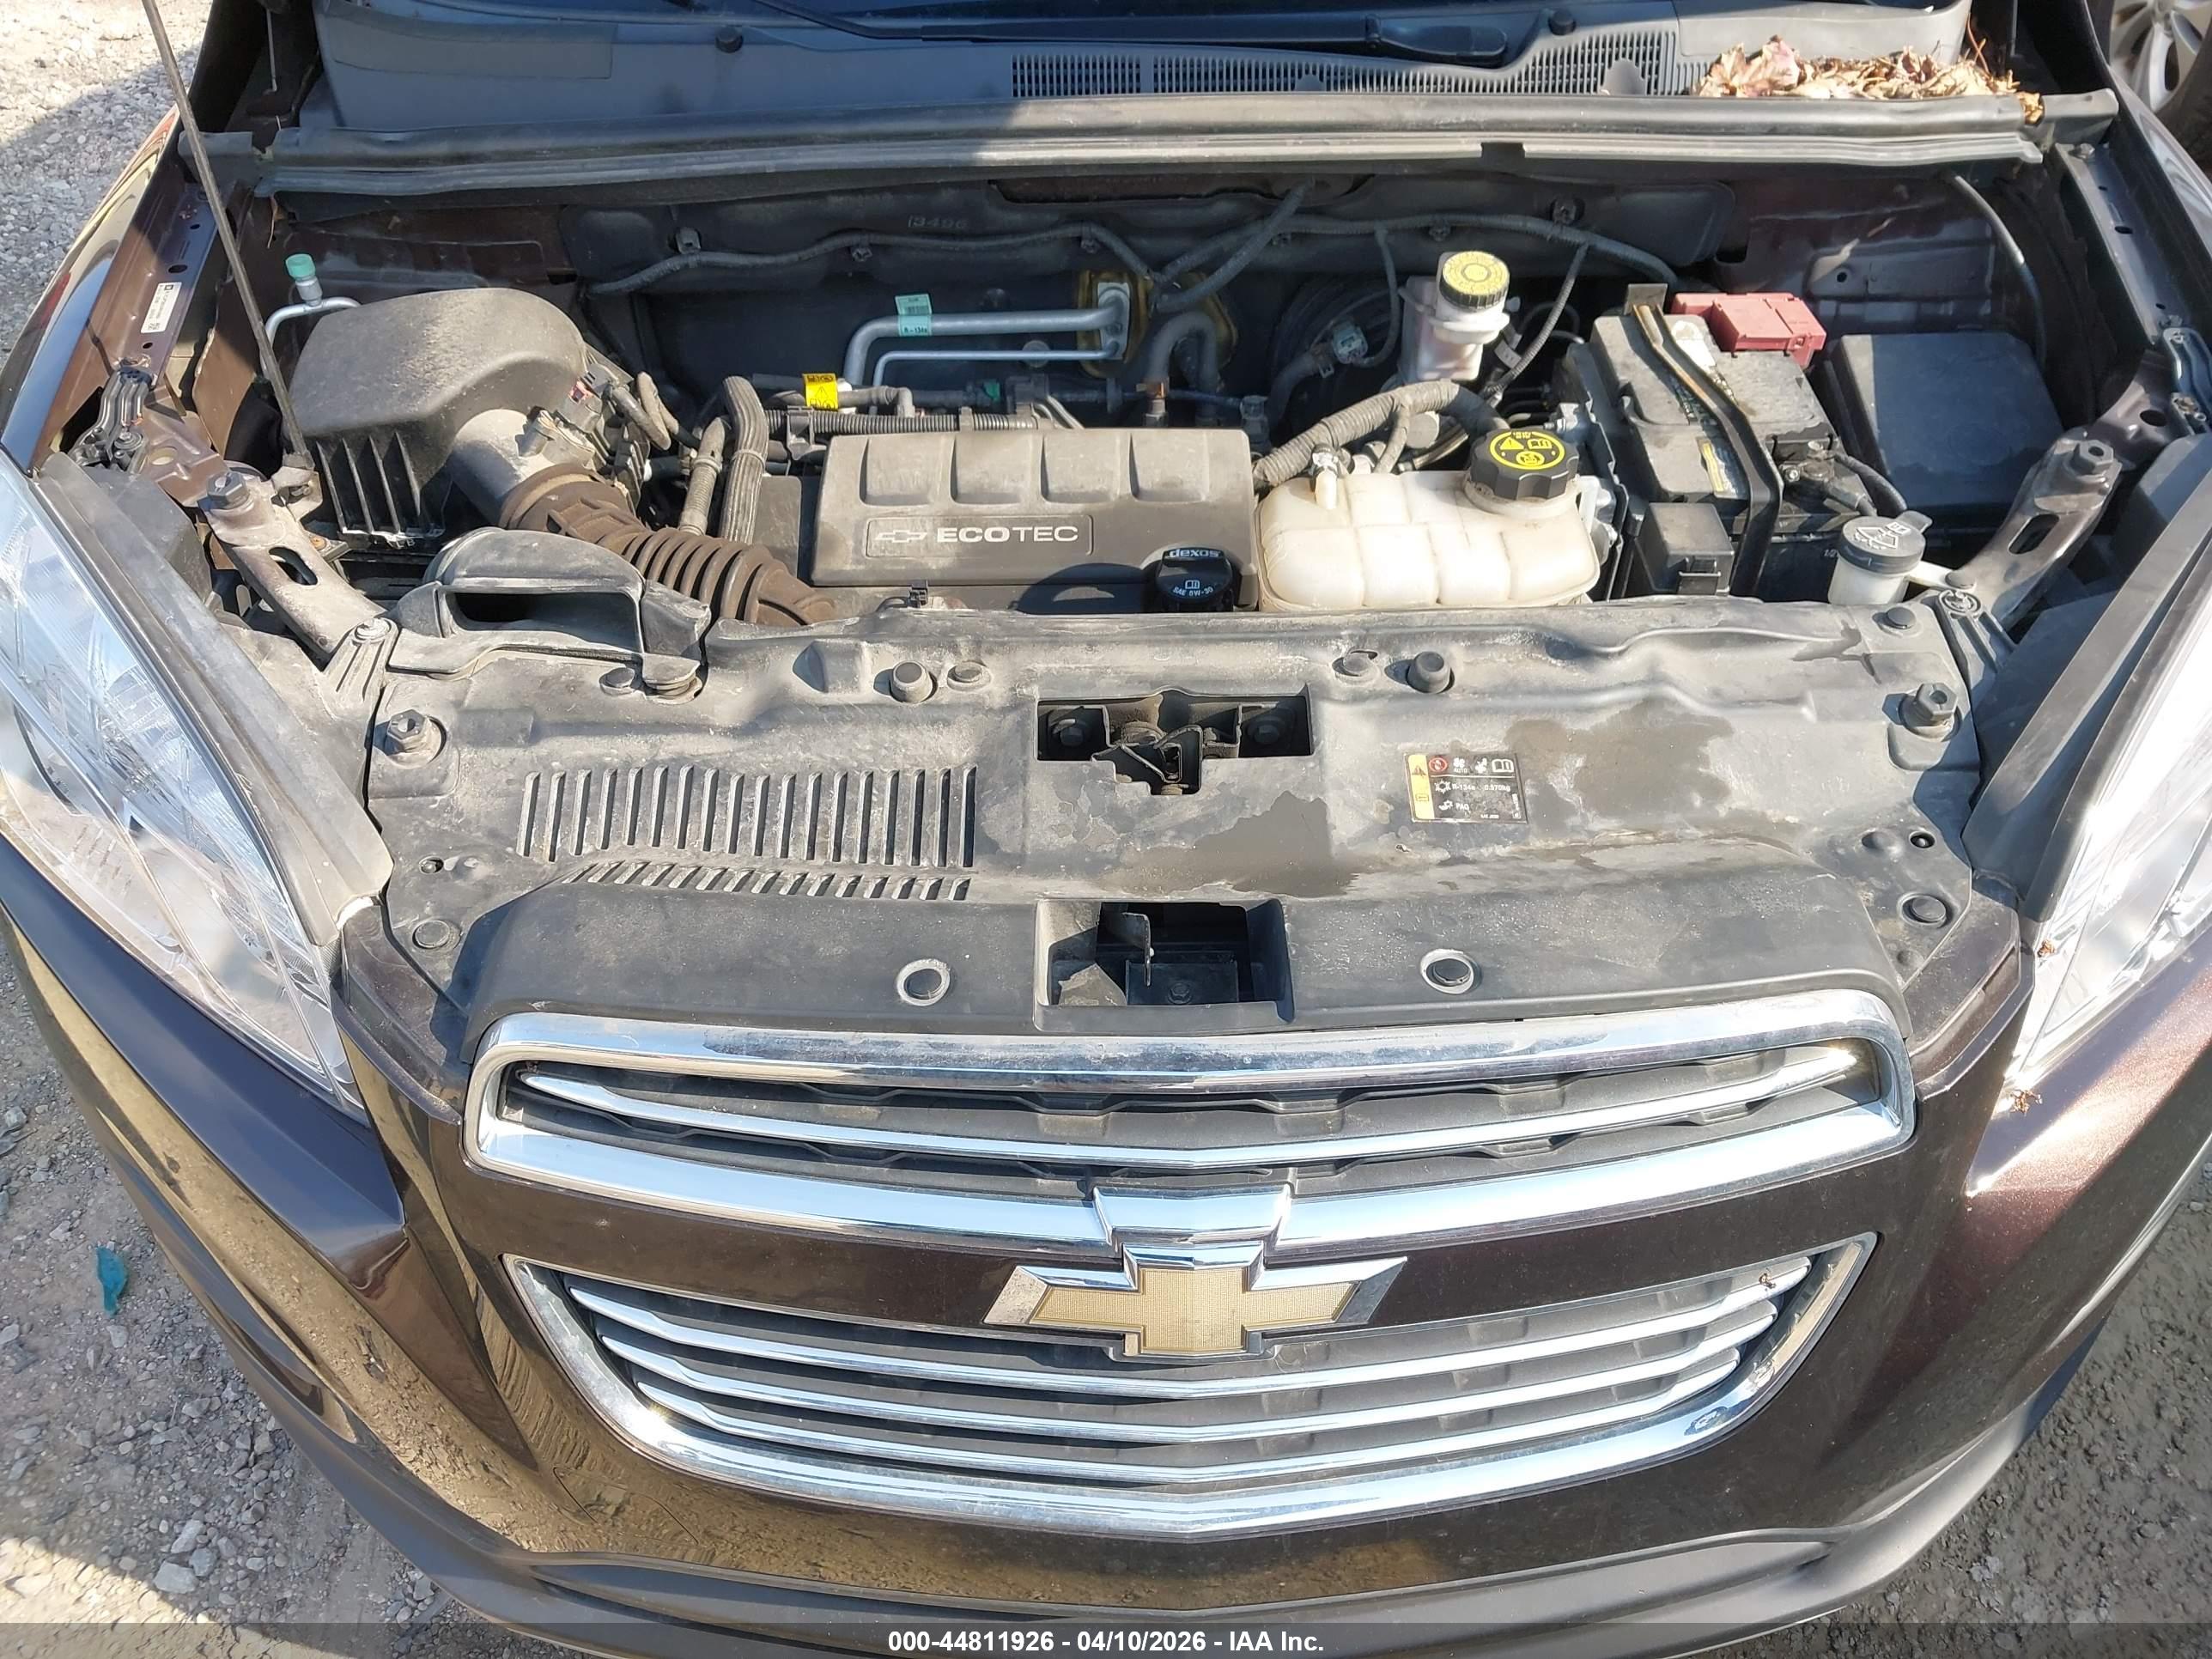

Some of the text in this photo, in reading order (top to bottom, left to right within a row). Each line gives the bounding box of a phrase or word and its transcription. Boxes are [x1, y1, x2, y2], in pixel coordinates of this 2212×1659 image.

[937, 526, 1079, 543] ECOTEC
[1170, 549, 1219, 557] dexos
[1173, 586, 1187, 597] SAE
